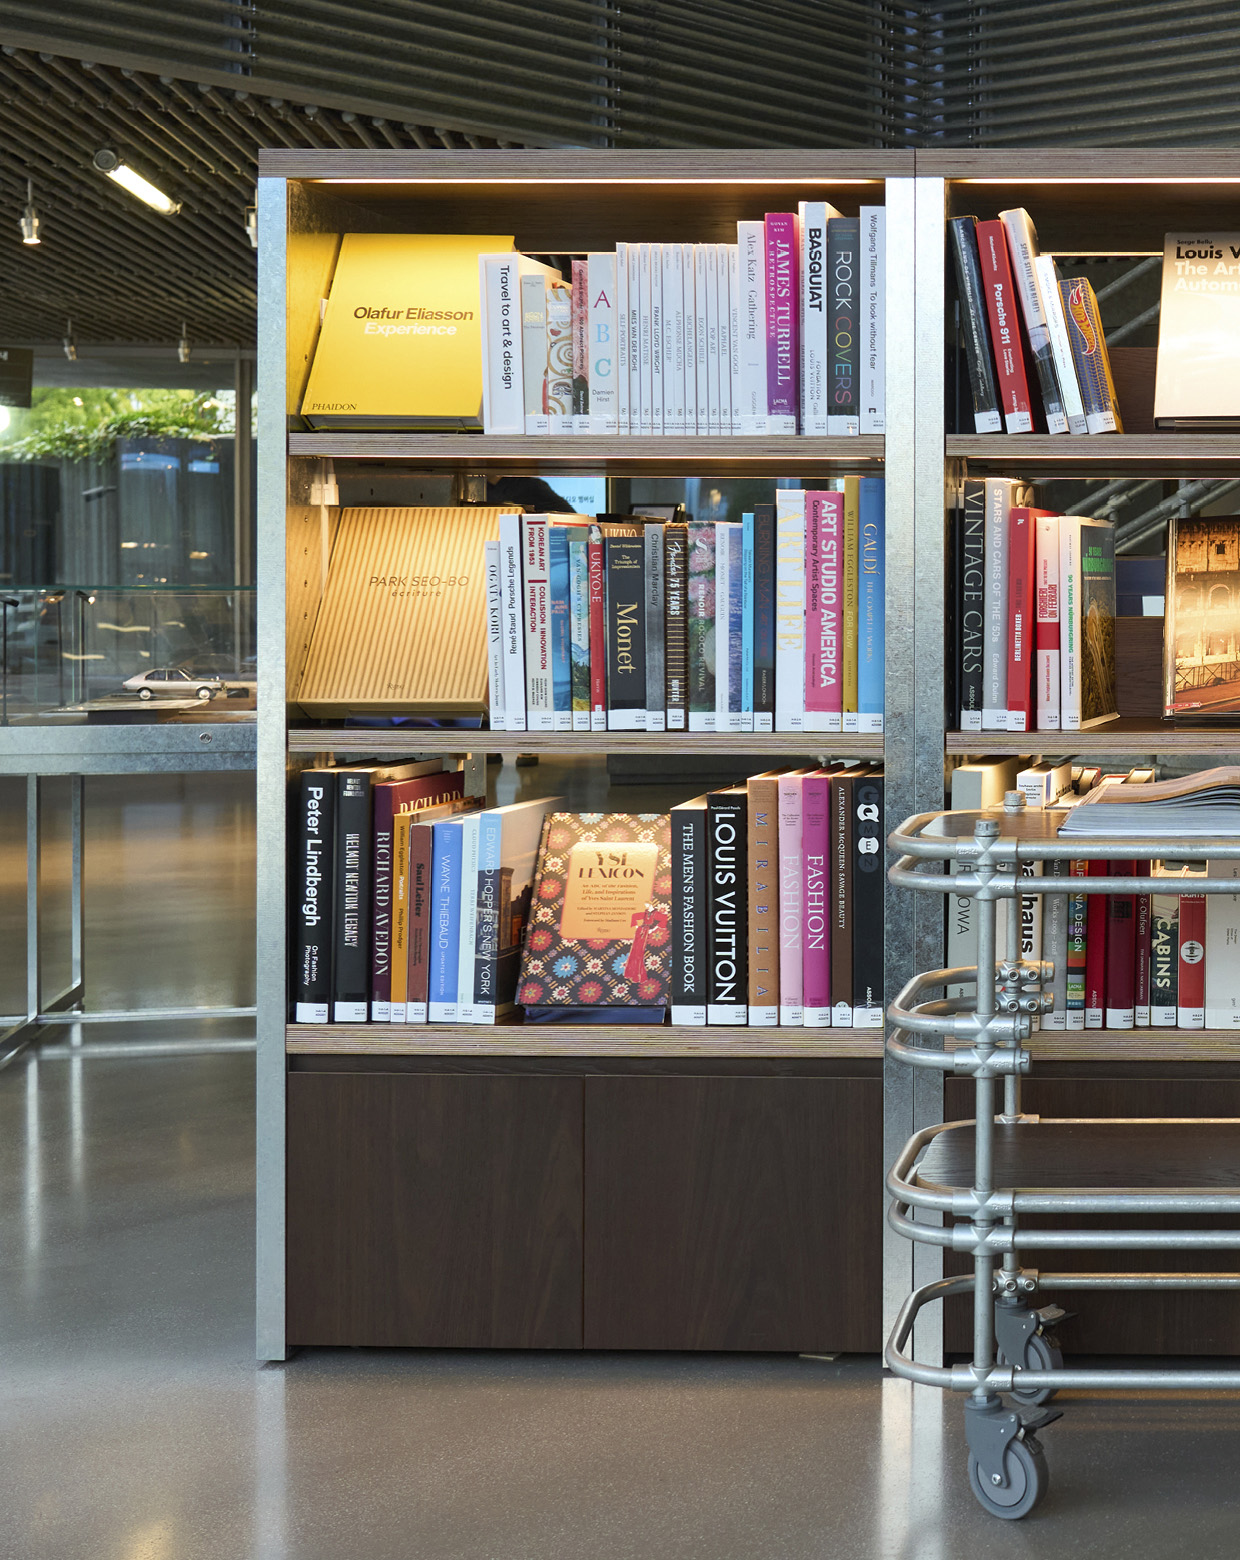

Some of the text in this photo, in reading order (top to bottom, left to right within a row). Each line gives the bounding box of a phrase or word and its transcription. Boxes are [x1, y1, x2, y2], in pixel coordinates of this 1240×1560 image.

[809, 228, 822, 311] BASQUIAT
[1175, 261, 1208, 275] The
[1176, 246, 1222, 258] Louis
[354, 307, 473, 320] Olafur Eliasson
[500, 265, 513, 389] Travel to art & design
[776, 240, 790, 386] JAMES TURRELL
[835, 251, 852, 403] ROCK COVERS
[869, 215, 878, 369] Wolfgang Tillmans To look without fear
[994, 284, 1010, 344] Porsche 911
[364, 322, 457, 337] Experience
[653, 306, 661, 374] FRANK LLOYD WRIGHT
[312, 403, 357, 412] PHAIDON
[592, 388, 614, 396] Damien
[369, 576, 469, 586] PARK SEO-BO
[527, 528, 536, 565] FROM 1953
[537, 527, 546, 571] KOREAN ART
[650, 534, 659, 606] Christian Marclay
[811, 500, 820, 611] Contemporary Artist Spaces
[863, 523, 880, 575] GAUDÍ
[962, 489, 984, 673] VINTAGE CARS
[529, 586, 537, 632] INTERACTION
[538, 586, 548, 670] COLLISION INNOVATION
[820, 500, 837, 688] ART STUDIO AMERICA
[991, 489, 1002, 703] STARS AND CARS OF THE '50s Edward Quinn
[617, 602, 638, 674] Monet
[302, 787, 323, 926] Peter Lindbergh
[375, 832, 390, 975] RICHARD AVEDON
[439, 855, 451, 948] WAYNE THIEBAUD
[480, 827, 495, 994] EDWARD HOPPER'S NEW YORK
[682, 823, 695, 993] THE MEN'S FASHION BOOK
[715, 813, 736, 1000] LOUIS VUITTON
[807, 855, 824, 950] FASHION
[1074, 914, 1083, 952] DESIGN
[303, 945, 312, 986] Photography
[310, 945, 319, 981] On Fashion
[1156, 918, 1171, 988] CABINS
